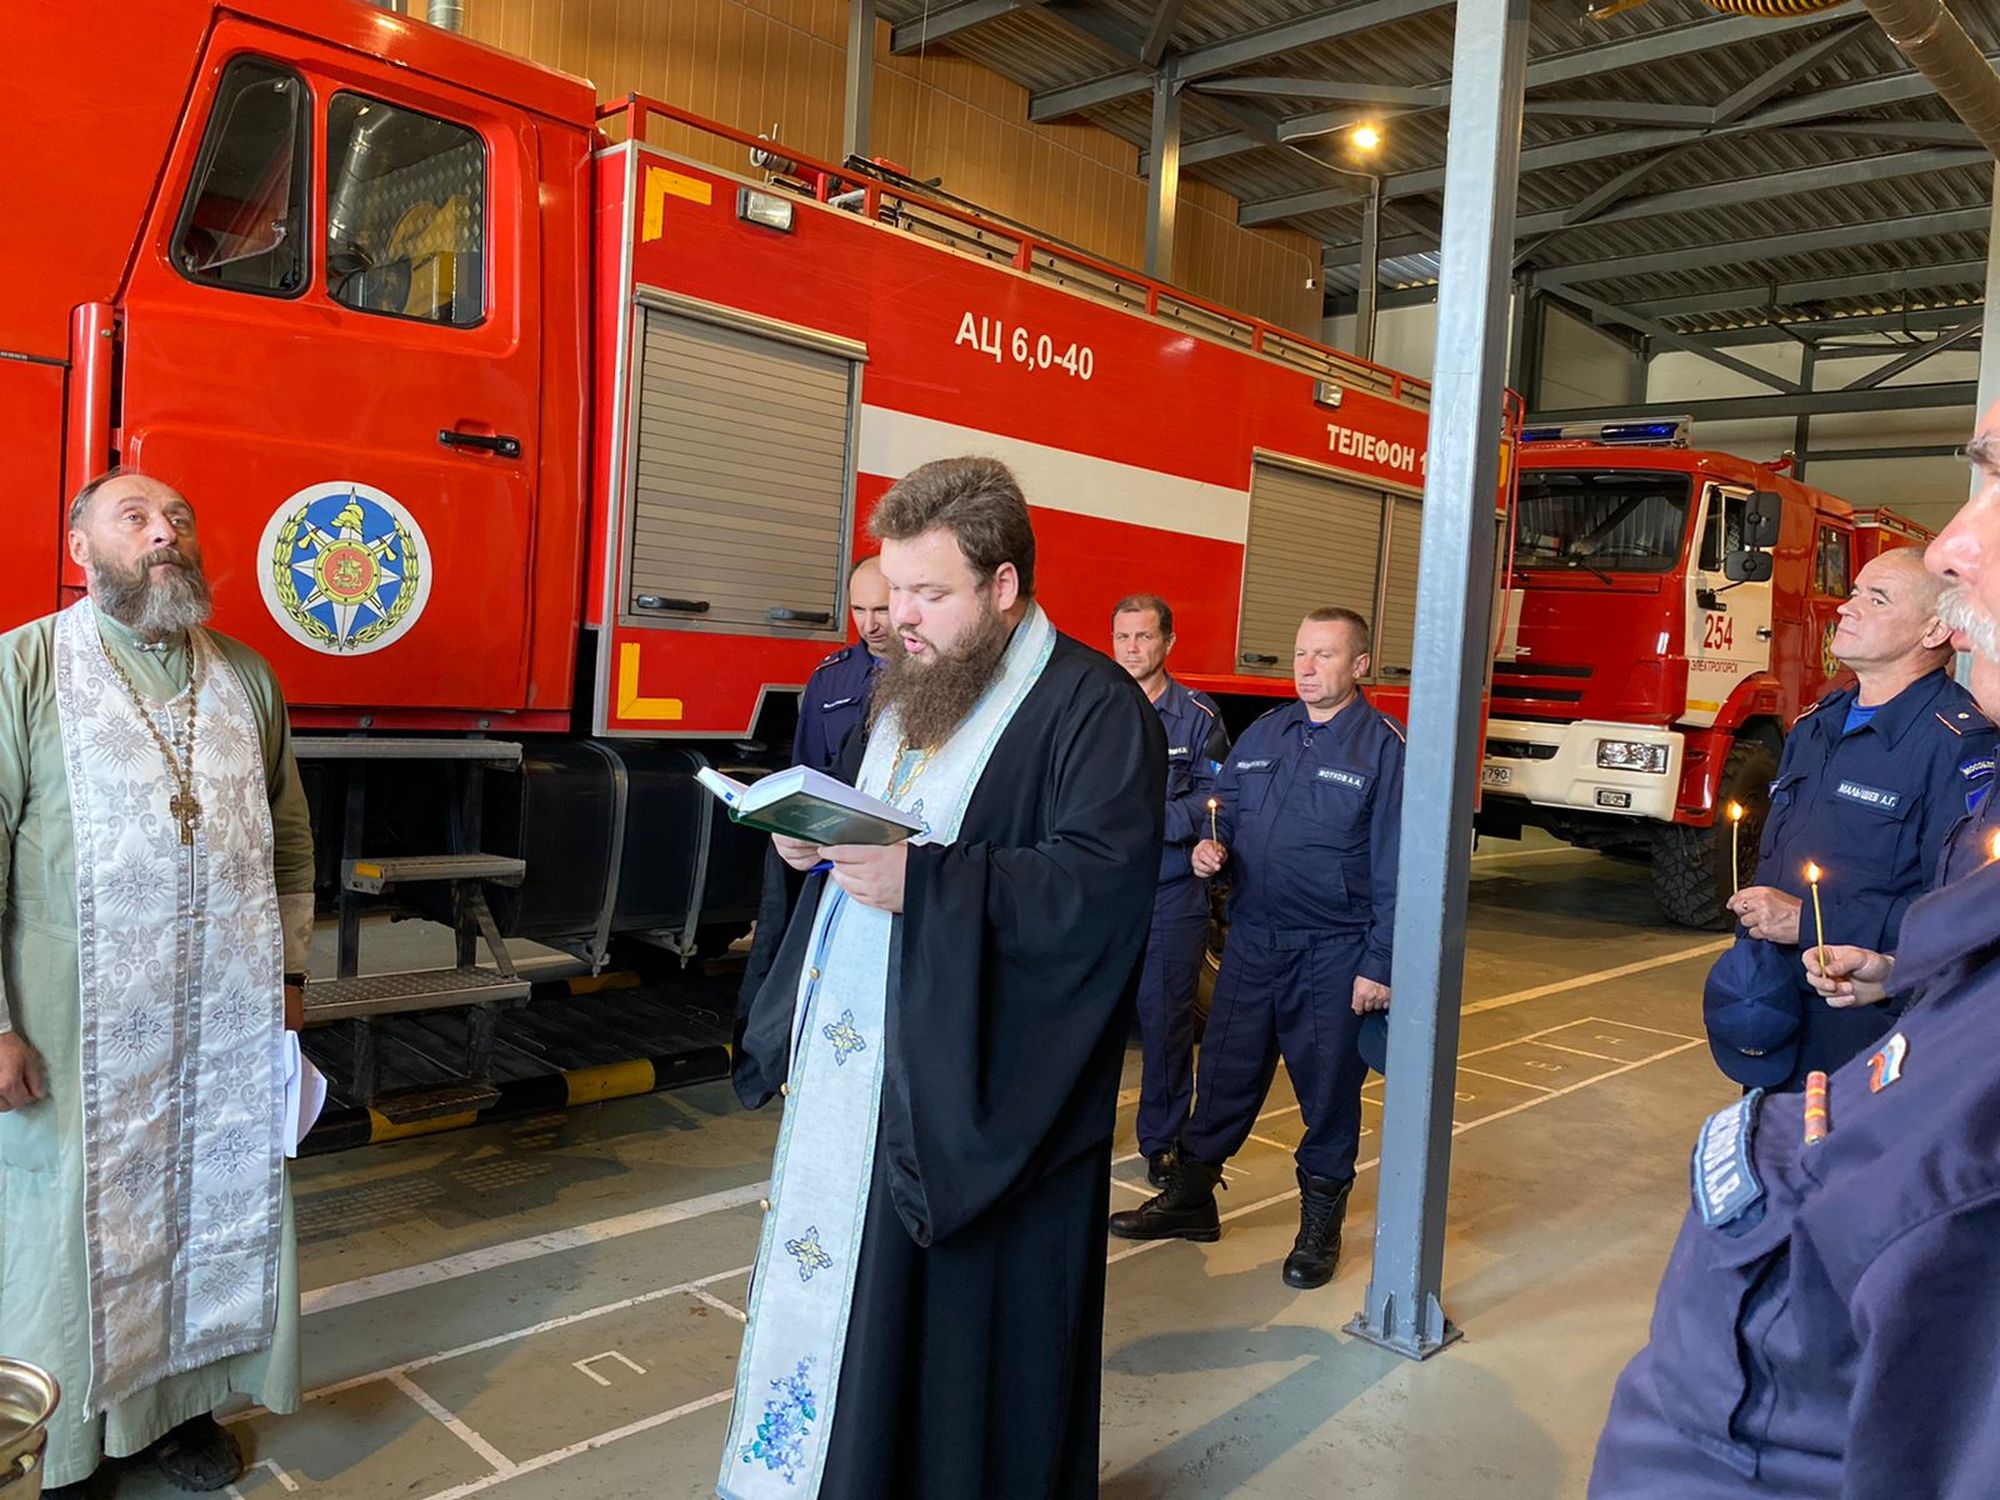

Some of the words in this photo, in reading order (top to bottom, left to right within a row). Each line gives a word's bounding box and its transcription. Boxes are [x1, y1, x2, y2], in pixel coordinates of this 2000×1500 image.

[954, 311, 1002, 363] АЦ
[1012, 326, 1094, 380] 6,0-40
[1327, 423, 1415, 472] ТЕЛЕФОН
[1703, 613, 1733, 651] 254
[1691, 660, 1739, 673] ЭЛЕКТРОГОРСК
